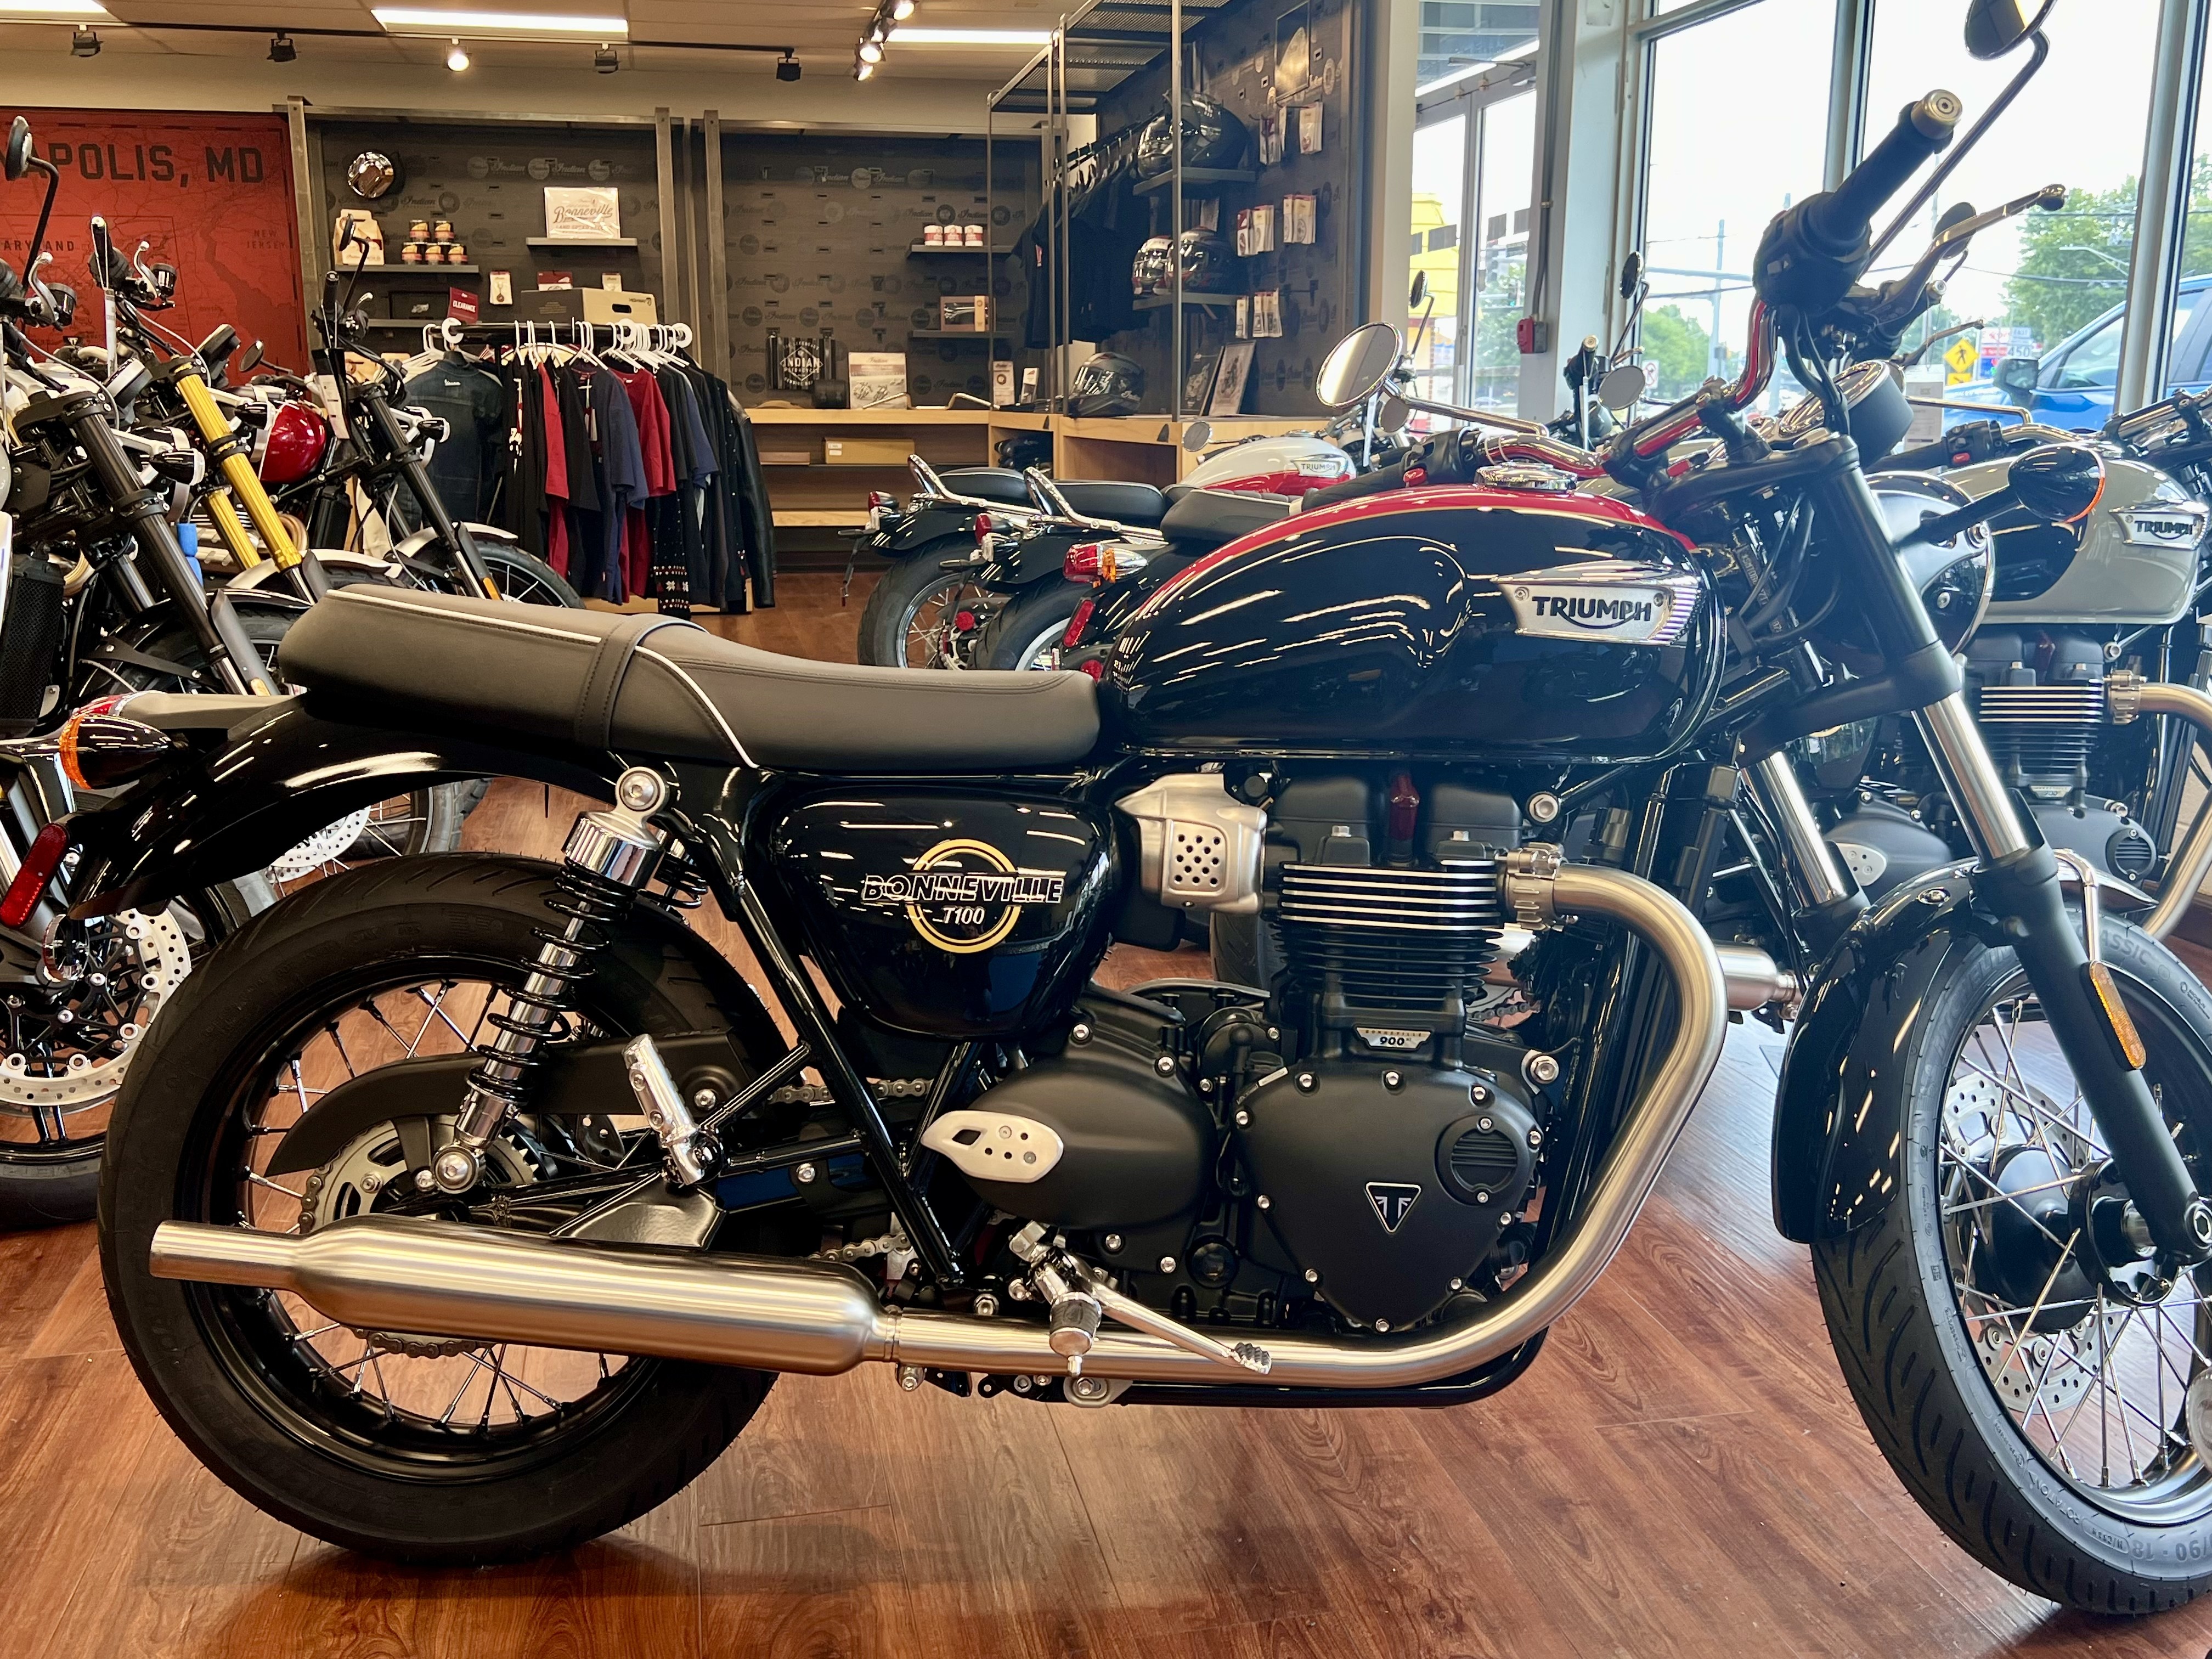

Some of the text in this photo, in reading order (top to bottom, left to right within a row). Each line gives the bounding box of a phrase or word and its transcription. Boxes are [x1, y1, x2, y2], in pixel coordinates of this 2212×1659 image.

[205, 145, 264, 183] MD
[552, 163, 586, 173] Indian
[553, 204, 613, 224] Bonneville
[4, 240, 75, 252] ARYAND
[452, 300, 476, 313] CLEARANCE
[2008, 346, 2030, 357] 450
[783, 357, 820, 368] INDIAN
[1301, 462, 1336, 473] TRIUMPH
[2134, 520, 2193, 540] TRIUMPH
[1532, 596, 1651, 629] TRIUMPH
[861, 874, 1065, 904] BONNEVILLE
[943, 907, 985, 925] T100
[1365, 1029, 1422, 1037] BONNEVILLE
[1379, 1036, 1406, 1046] 900
[2176, 1538, 2212, 1561] /90
